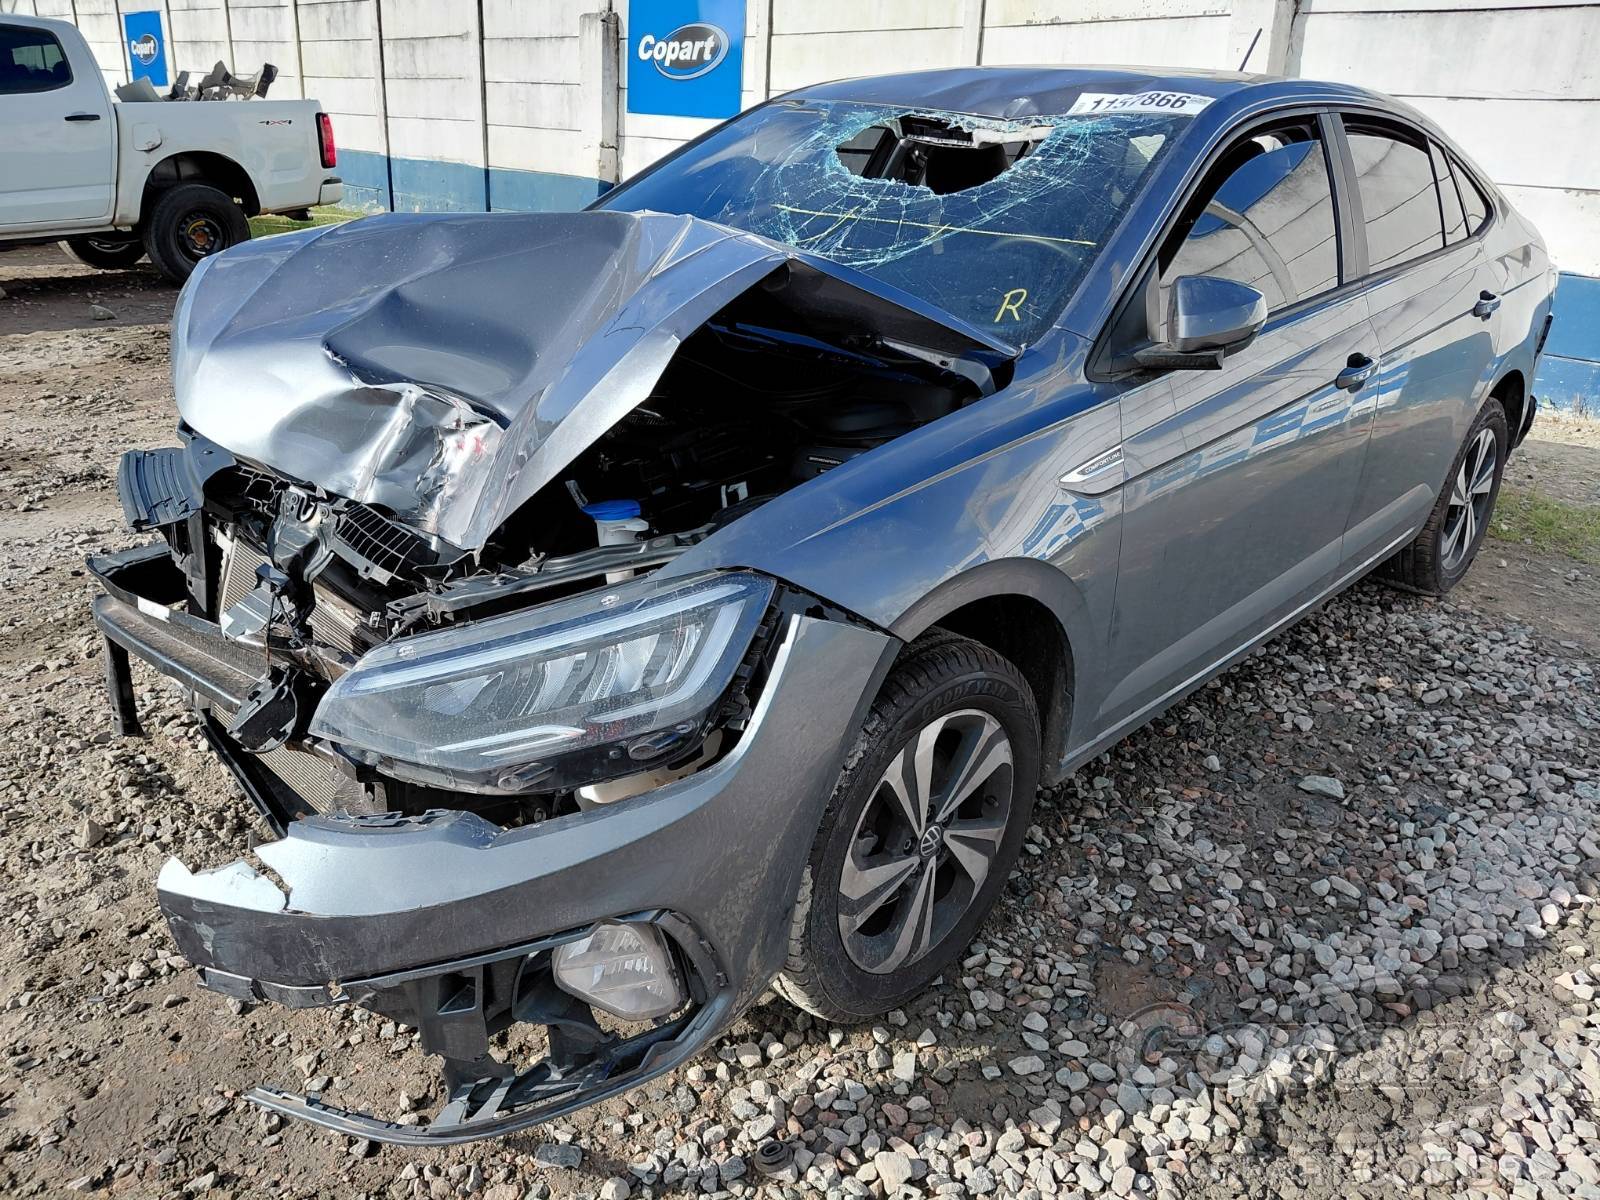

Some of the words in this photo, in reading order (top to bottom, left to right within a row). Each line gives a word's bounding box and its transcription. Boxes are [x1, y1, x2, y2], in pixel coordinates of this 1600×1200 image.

[131, 40, 155, 58] Copart
[638, 34, 715, 66] Copart
[994, 288, 1027, 322] R
